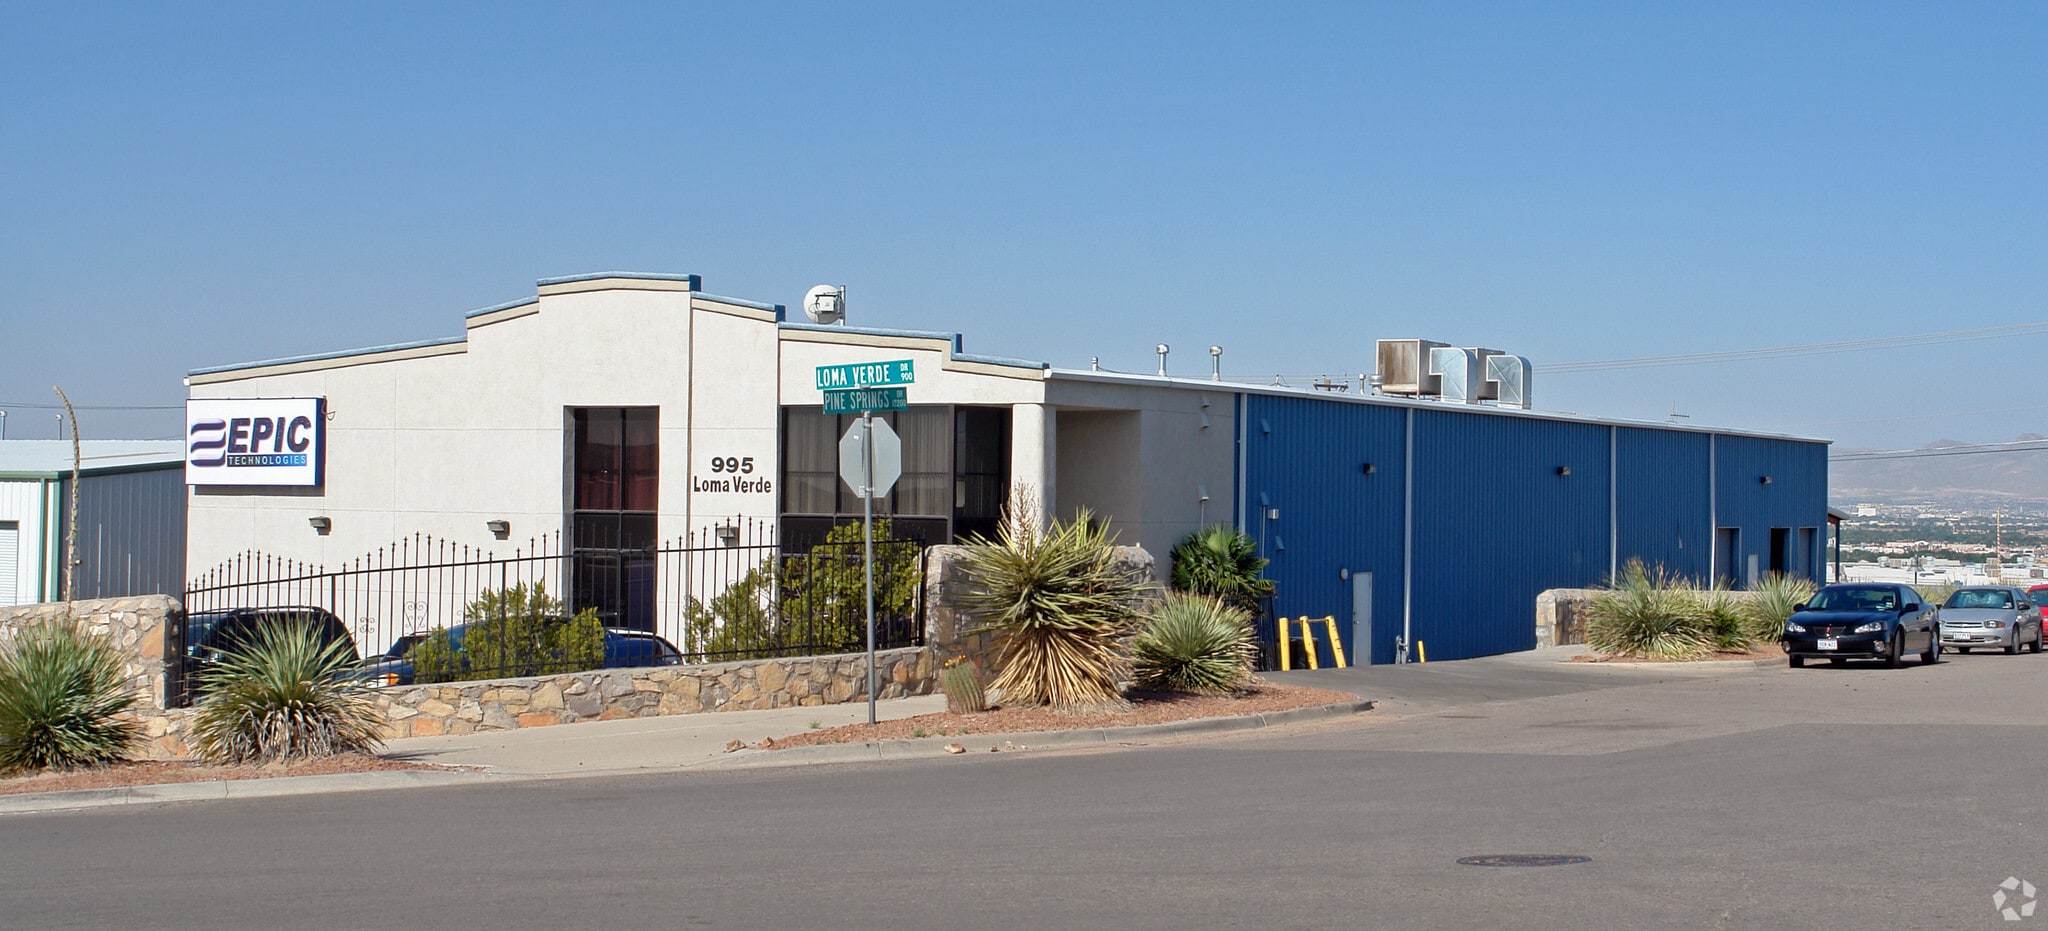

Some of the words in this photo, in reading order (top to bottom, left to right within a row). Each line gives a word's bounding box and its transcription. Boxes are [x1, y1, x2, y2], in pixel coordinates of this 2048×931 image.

[817, 368, 848, 386] LOMA
[852, 364, 890, 385] VERDE
[900, 363, 908, 372] DR
[901, 372, 912, 380] 900
[824, 393, 846, 410] PINE
[850, 391, 890, 409] SPRINGS
[896, 390, 903, 398] DR
[228, 416, 311, 453] EPIC
[229, 456, 306, 465] TECHNOLOGIES
[712, 457, 754, 474] 995
[694, 476, 730, 492] Loma
[733, 476, 771, 493] Verde
